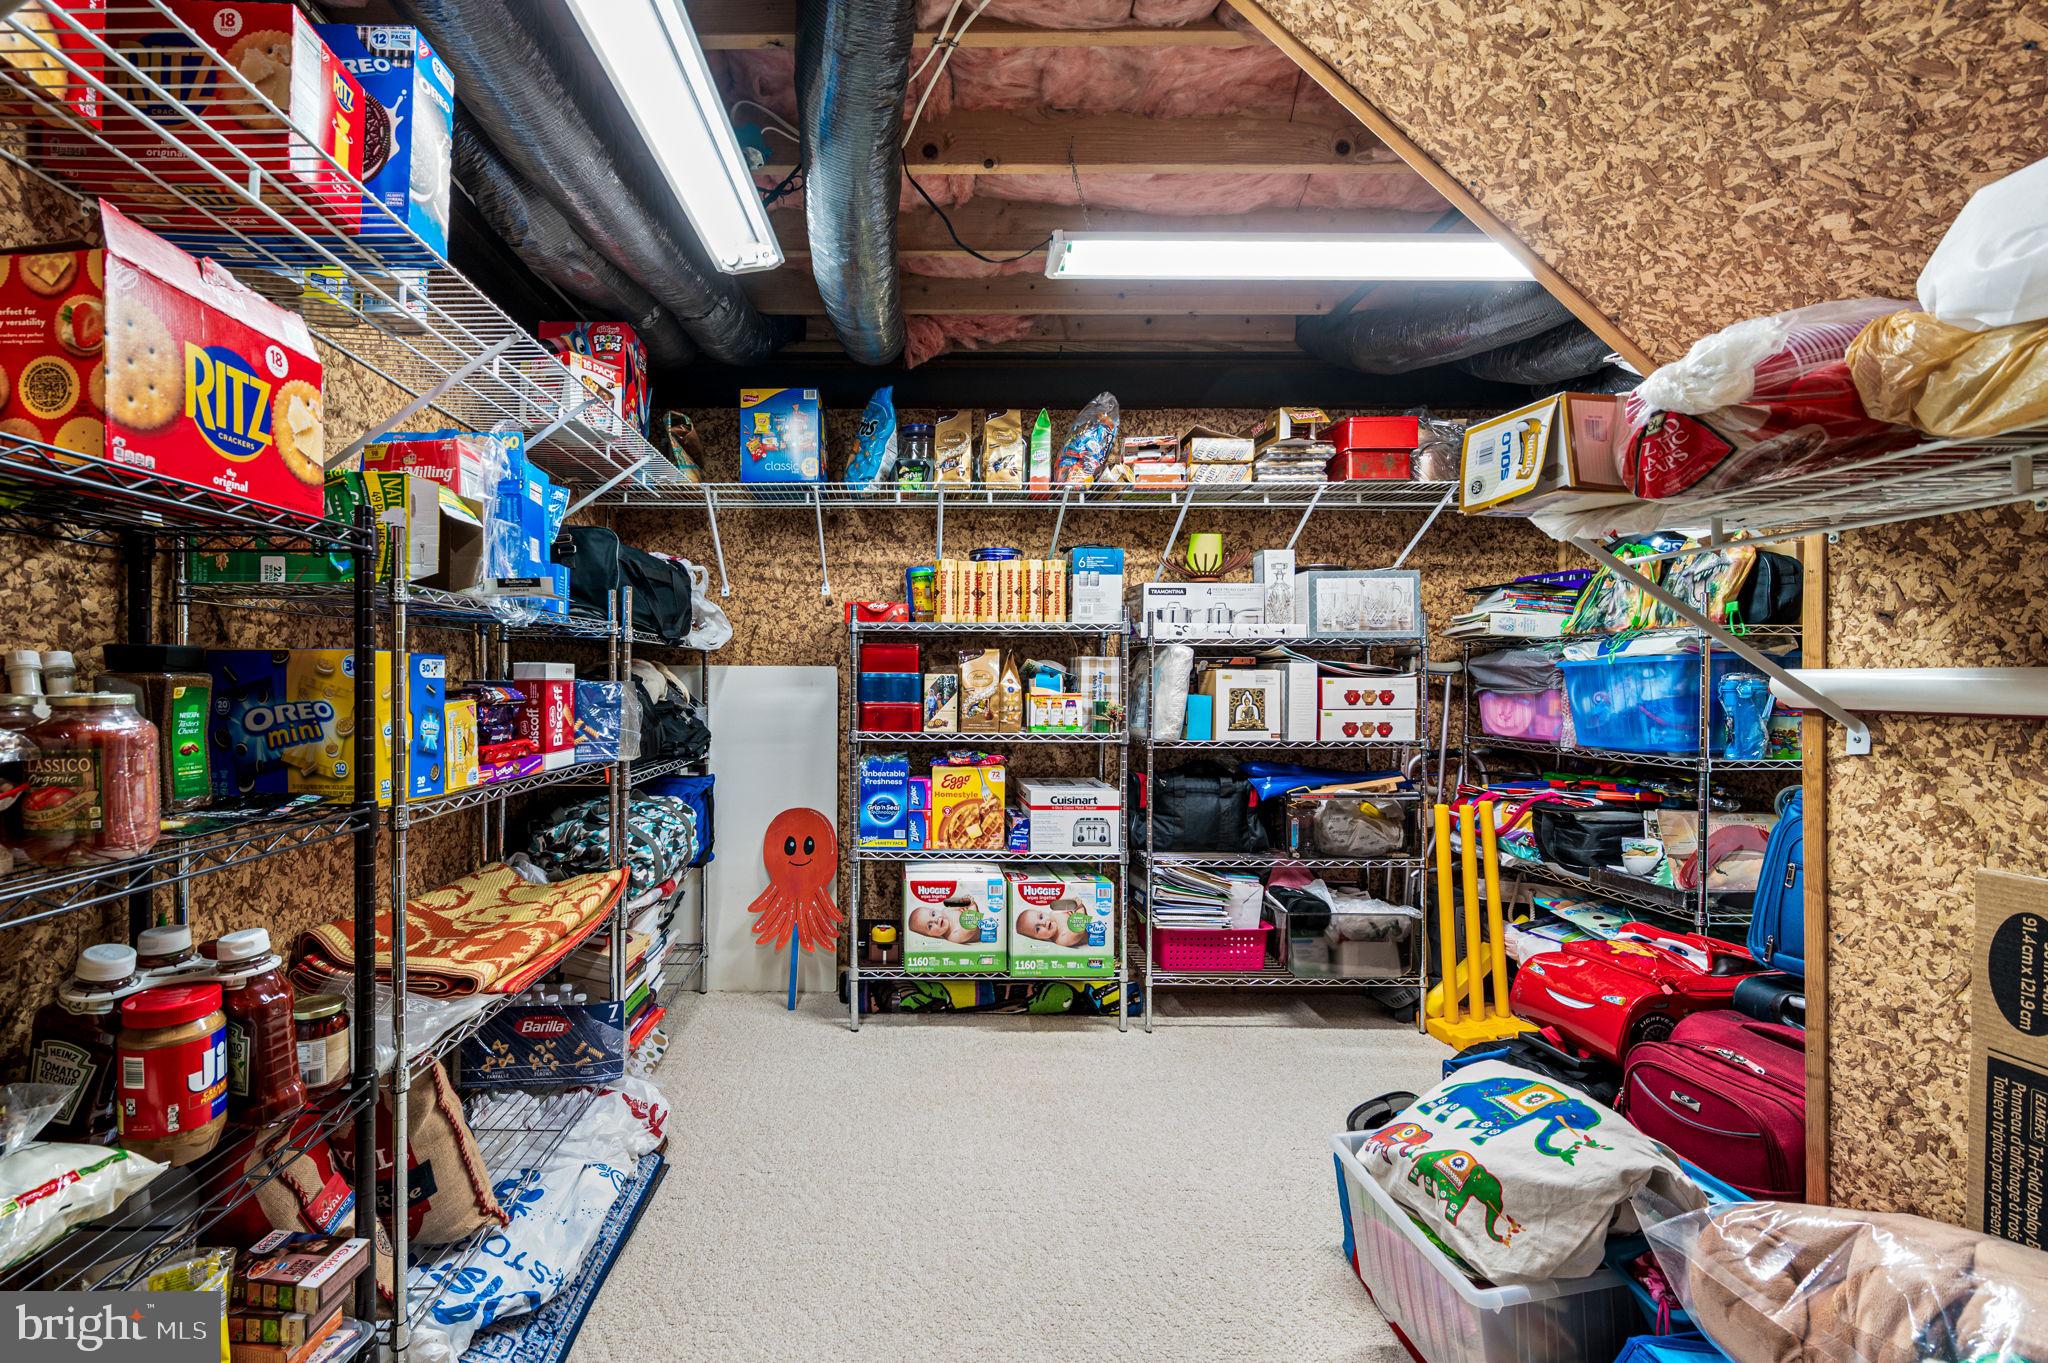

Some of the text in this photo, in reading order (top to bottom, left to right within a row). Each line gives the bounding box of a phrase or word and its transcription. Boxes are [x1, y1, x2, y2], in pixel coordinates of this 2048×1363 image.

[219, 14, 236, 27] 18
[372, 34, 387, 44] 12
[341, 58, 391, 74] REO
[333, 69, 355, 112] RITZ
[24, 307, 36, 315] for
[6, 318, 46, 328] versatility
[593, 334, 623, 344] FROOT
[595, 342, 621, 352] LOOPS
[269, 349, 285, 368] 18
[593, 363, 616, 381] PACK
[184, 341, 273, 446] RITZ
[218, 431, 256, 451] CRACKERS
[1500, 431, 1512, 481] SOLO
[1521, 432, 1536, 476] Spoons
[226, 468, 237, 478] the
[408, 464, 454, 483] Milling
[764, 460, 800, 472] classic
[1644, 449, 1689, 482] CUPS
[213, 474, 248, 493] original
[371, 492, 386, 546] 49 PCHES
[1079, 556, 1086, 568] 6
[963, 570, 971, 615] TOBLERONE
[1207, 587, 1212, 596] 4
[421, 664, 430, 673] 30
[217, 700, 228, 709] 20
[245, 701, 332, 732] OREO
[553, 685, 563, 747] Biscoff
[267, 720, 323, 749] mini
[27, 758, 91, 773] LASSICO
[335, 763, 346, 771] 10
[28, 774, 78, 786] Organic
[381, 780, 390, 789] 10
[417, 776, 426, 784] 20
[941, 774, 971, 790] Eggo
[911, 785, 920, 805] Ziploc
[934, 791, 978, 799] Homestyle
[1050, 796, 1098, 805] Cuisinart
[910, 819, 919, 842] Ziploc
[918, 886, 950, 895] HUGGIES
[1024, 886, 1060, 895] HUGGIES
[979, 920, 996, 928] Plus
[1086, 924, 1103, 932] Plus
[907, 957, 928, 967] 1160
[1015, 960, 1036, 970] 1160
[2019, 917, 2038, 1030] 91.4 cm x 121.9 cm
[608, 1003, 619, 1019] 7
[521, 1020, 566, 1033] Barilla
[1639, 1015, 1676, 1029] LIGHTYEA
[50, 1048, 78, 1062] HEINZ
[40, 1059, 81, 1079] TOMATO
[188, 1040, 225, 1092] Ji
[40, 1070, 77, 1085] KETCHUP
[2009, 1081, 2027, 1135] Panneau
[2033, 1093, 2048, 1140] ELMER'S
[1988, 1075, 2009, 1238] Tablero tríptico para presen
[2006, 1135, 2026, 1201] d'affichage
[2026, 1144, 2044, 1192] Tri-Fold
[316, 1192, 343, 1227] ROYAL
[323, 1195, 353, 1235] ASMATI RICE
[2023, 1192, 2042, 1238] Display
[2007, 1211, 2022, 1241] trois
